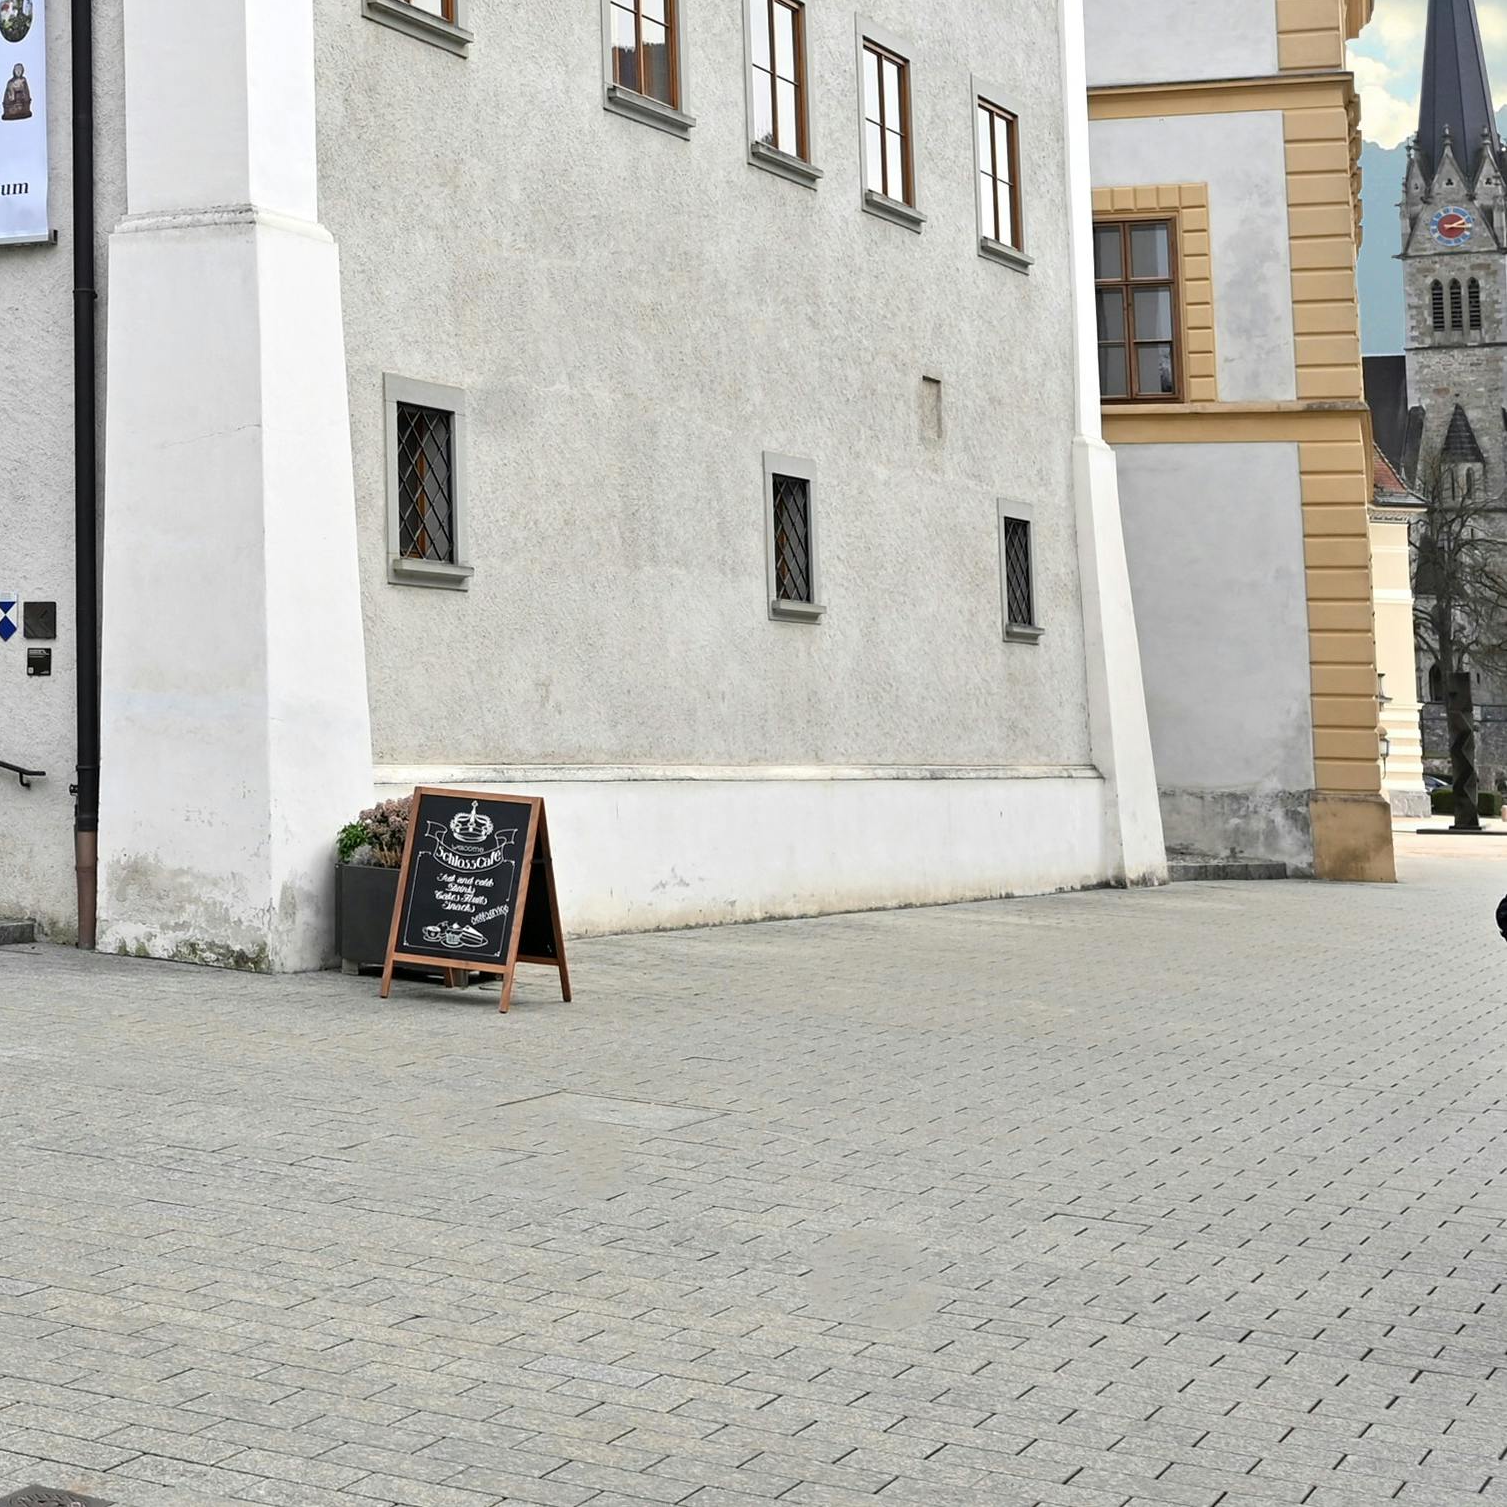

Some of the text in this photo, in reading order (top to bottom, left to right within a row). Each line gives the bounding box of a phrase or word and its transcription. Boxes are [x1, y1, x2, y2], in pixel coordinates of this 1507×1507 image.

[457, 876, 474, 885] and
[475, 878, 494, 887] cold
[445, 883, 476, 894] Drinks
[435, 890, 460, 902] Cakes
[441, 900, 476, 913] Snacks
